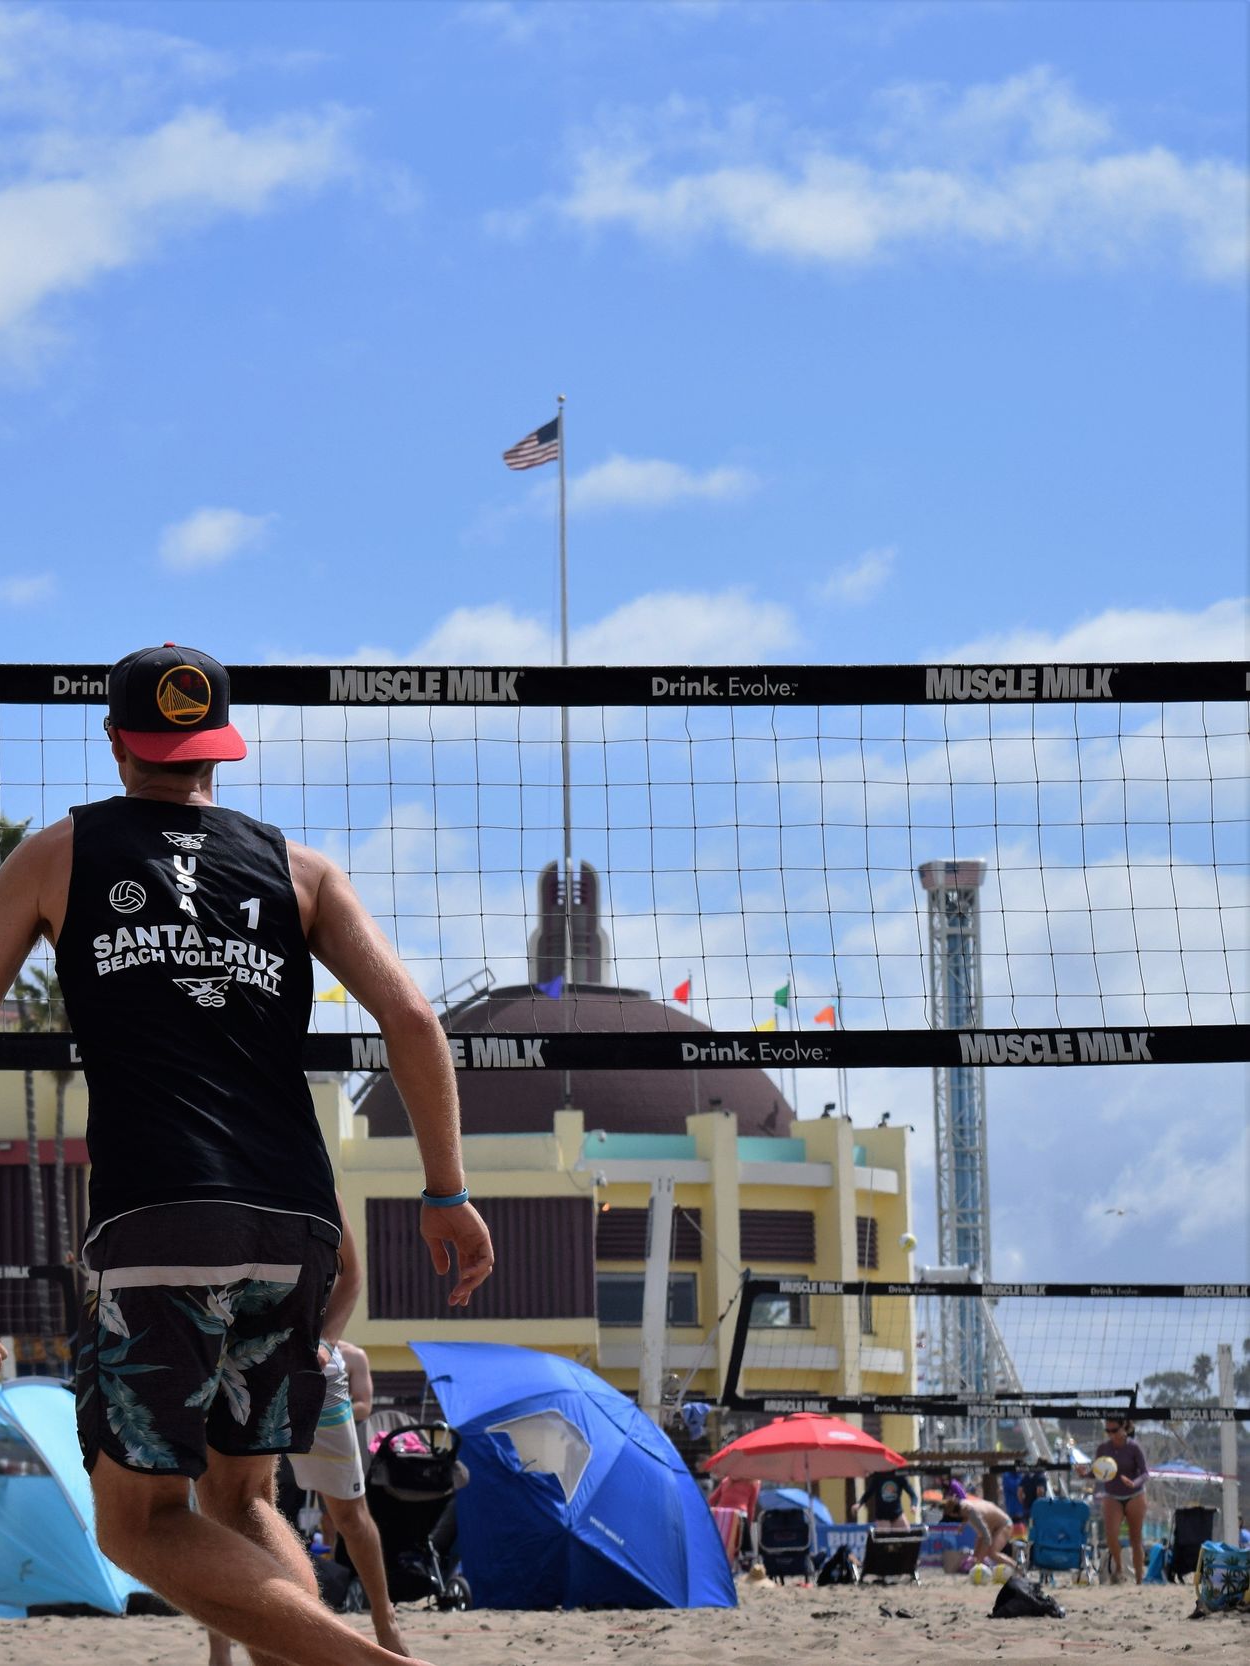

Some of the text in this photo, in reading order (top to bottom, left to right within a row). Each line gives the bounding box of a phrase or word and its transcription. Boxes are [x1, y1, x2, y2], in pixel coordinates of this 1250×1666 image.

[329, 669, 519, 702] MUSCLE MILK
[651, 674, 796, 697] Drink. Evolve.
[925, 667, 1113, 700] MUSCLE MILK
[240, 898, 261, 930] 1
[93, 924, 204, 959] SANTA
[96, 948, 281, 996] BEACH VOLLYBALL
[470, 1037, 546, 1068] MILK
[681, 1039, 826, 1062] Drink. Evolve.
[958, 1031, 1153, 1065] MUSCLE MILK
[780, 1281, 844, 1294] MUSCLE MILK
[982, 1284, 1046, 1296] MUSCLE MILK
[1184, 1286, 1248, 1297] MUSCLE MILK
[967, 1405, 1032, 1417] MUSCLE MILK
